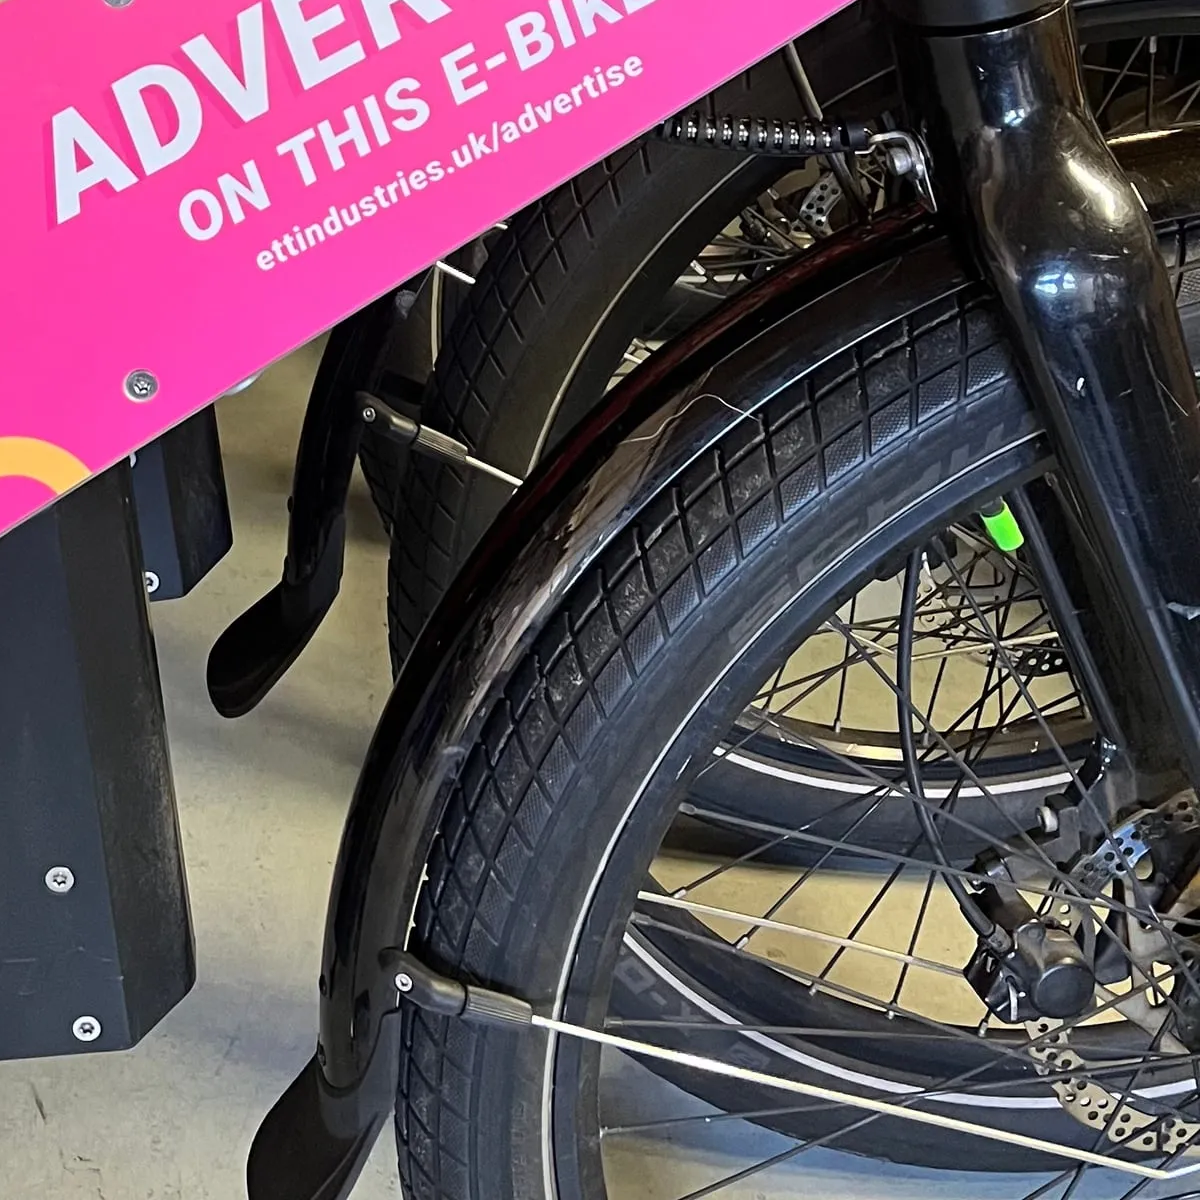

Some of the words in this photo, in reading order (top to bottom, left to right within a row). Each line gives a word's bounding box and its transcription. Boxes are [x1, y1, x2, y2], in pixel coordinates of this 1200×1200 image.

[178, 161, 272, 241] ON
[276, 77, 431, 186] THIS
[256, 56, 644, 272] ettindustries.uk/advertise
